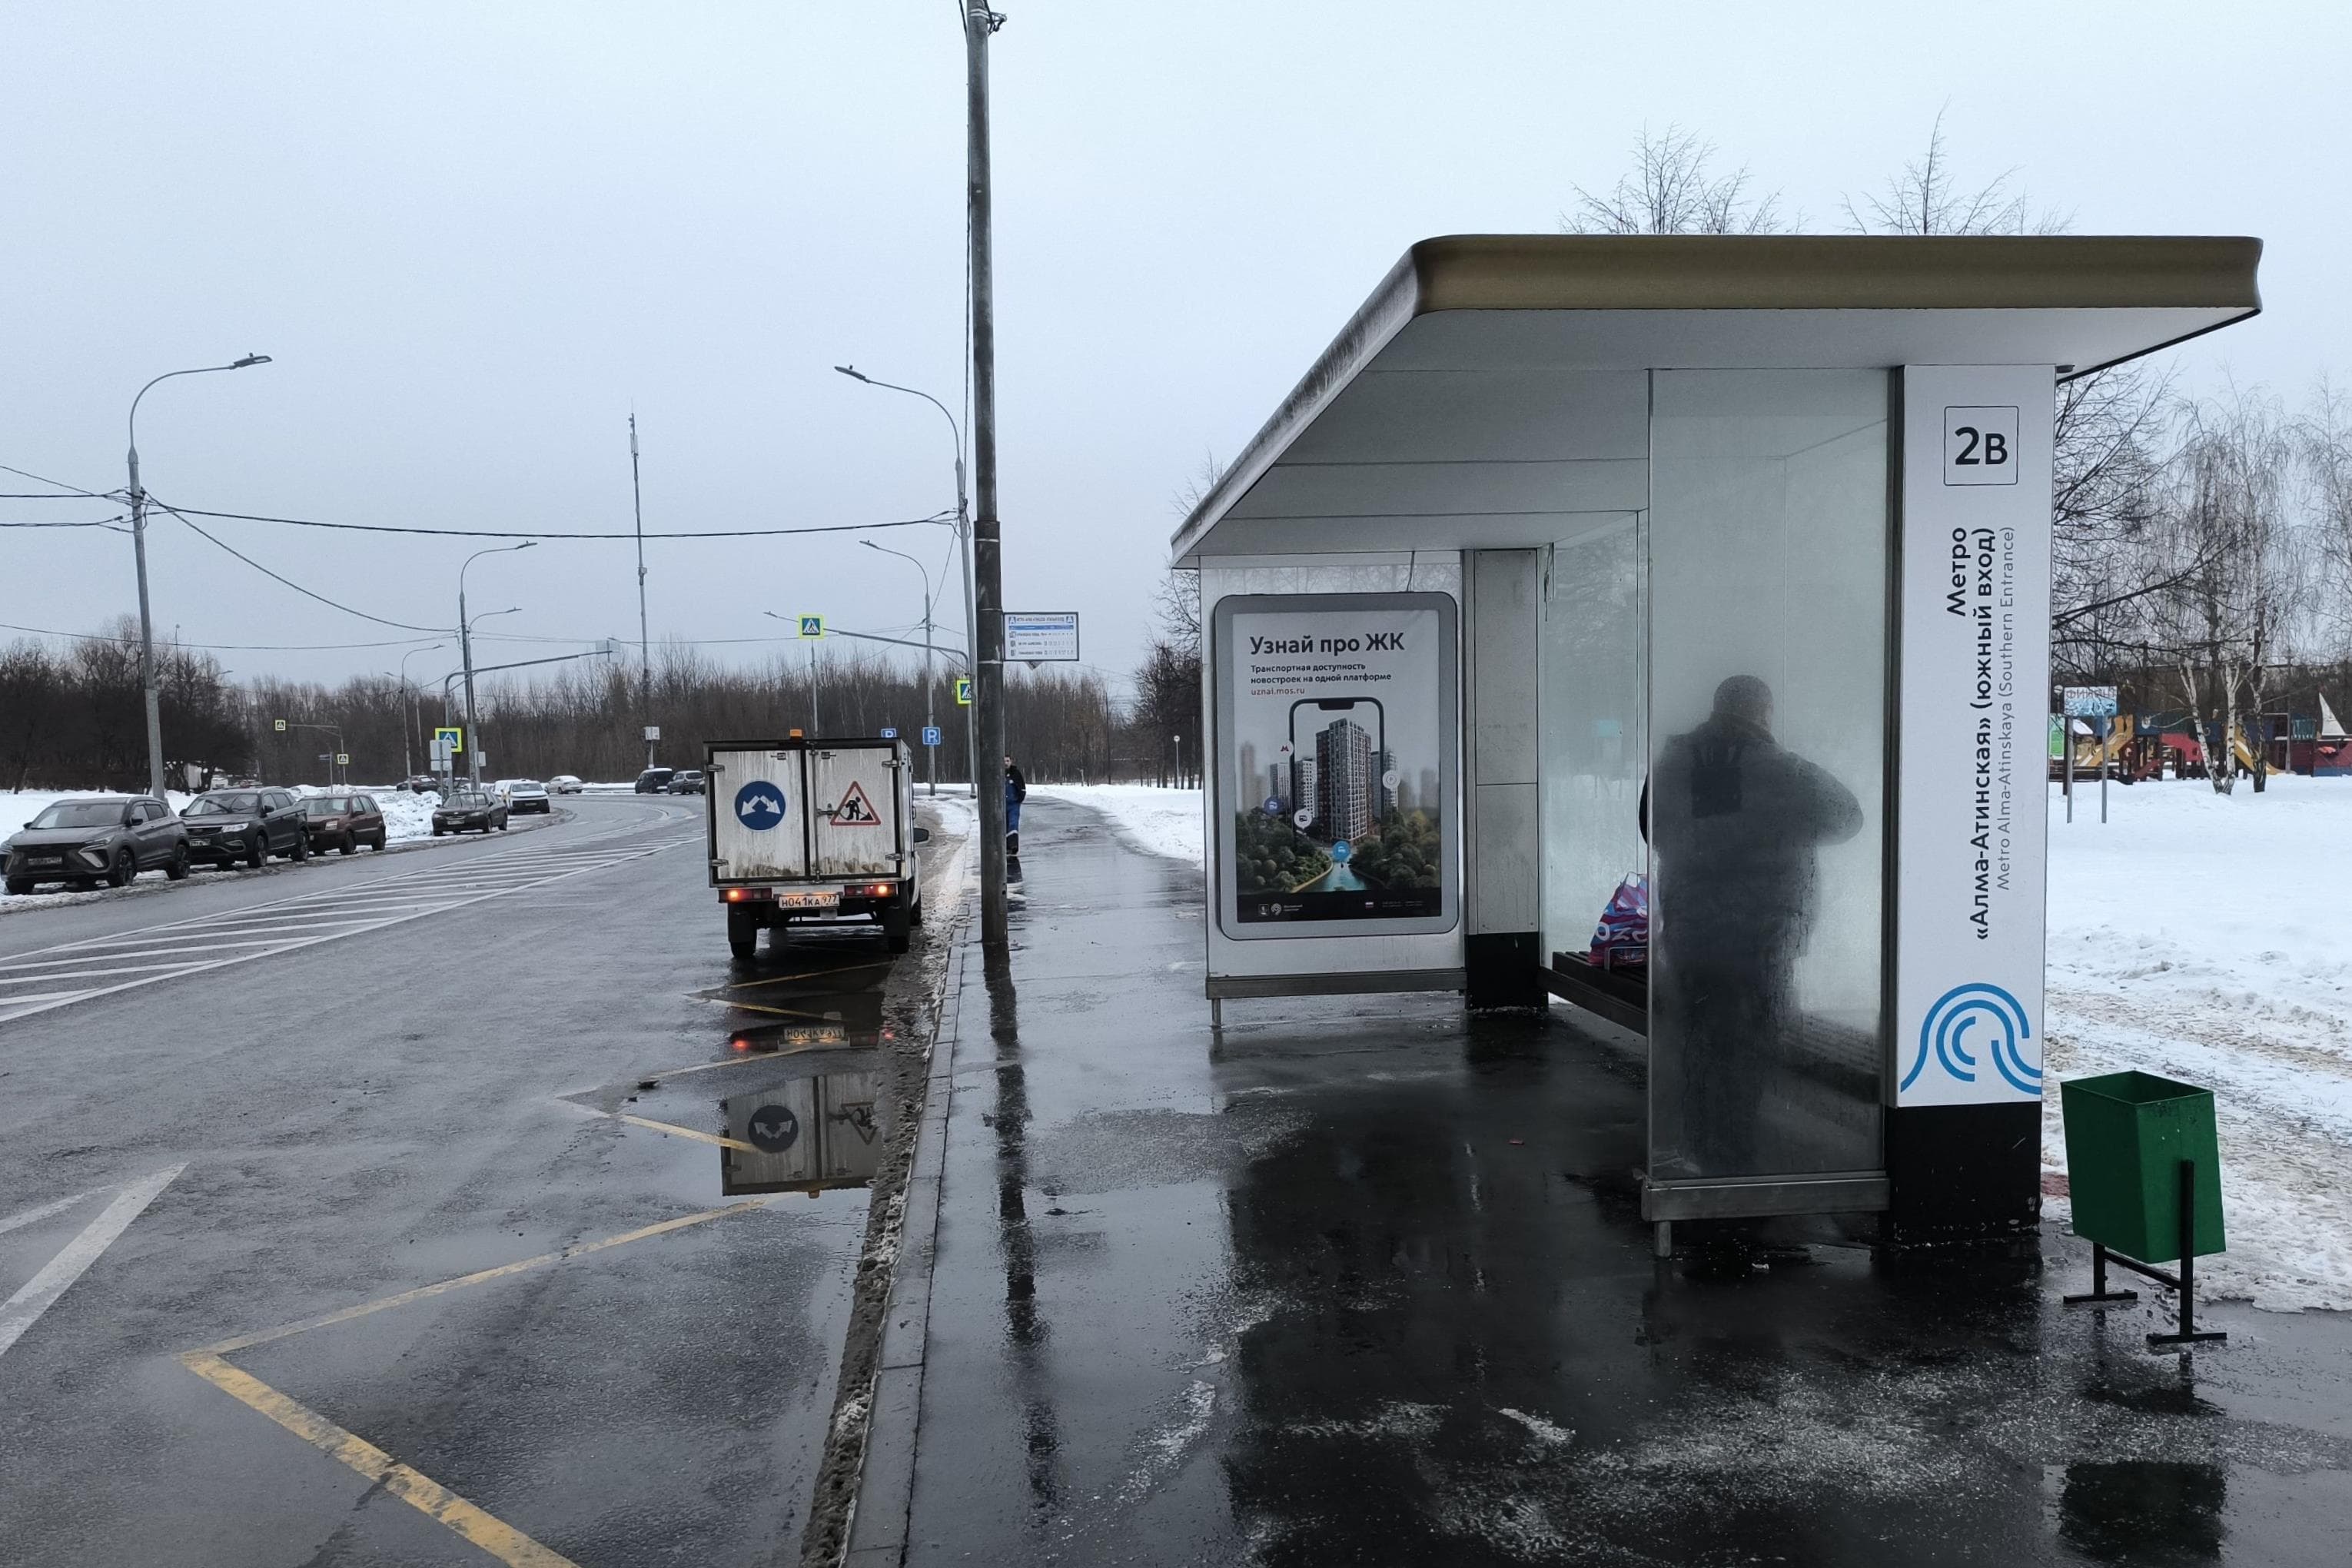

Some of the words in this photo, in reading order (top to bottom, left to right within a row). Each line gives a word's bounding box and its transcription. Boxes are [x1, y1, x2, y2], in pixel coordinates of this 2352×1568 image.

[1946, 527, 1971, 616] Метро
[1971, 528, 1995, 596] вход)
[1999, 527, 2015, 607] Entrance)
[1250, 635, 1313, 655] Узнай
[1321, 638, 1360, 656] про
[1365, 633, 1405, 651] ЖК
[1251, 664, 1311, 673] Транспортная
[1313, 663, 1366, 672] доступность
[1315, 674, 1341, 683] одной
[1344, 673, 1392, 683] платформе
[1969, 605, 1992, 709] (южный
[1998, 613, 2013, 696] (Southern
[927, 729, 937, 742] P
[1997, 703, 2015, 833] Alma-Atinskaya
[1970, 717, 1991, 940] «Алма-Атинская»
[1997, 838, 2010, 890] Metro
